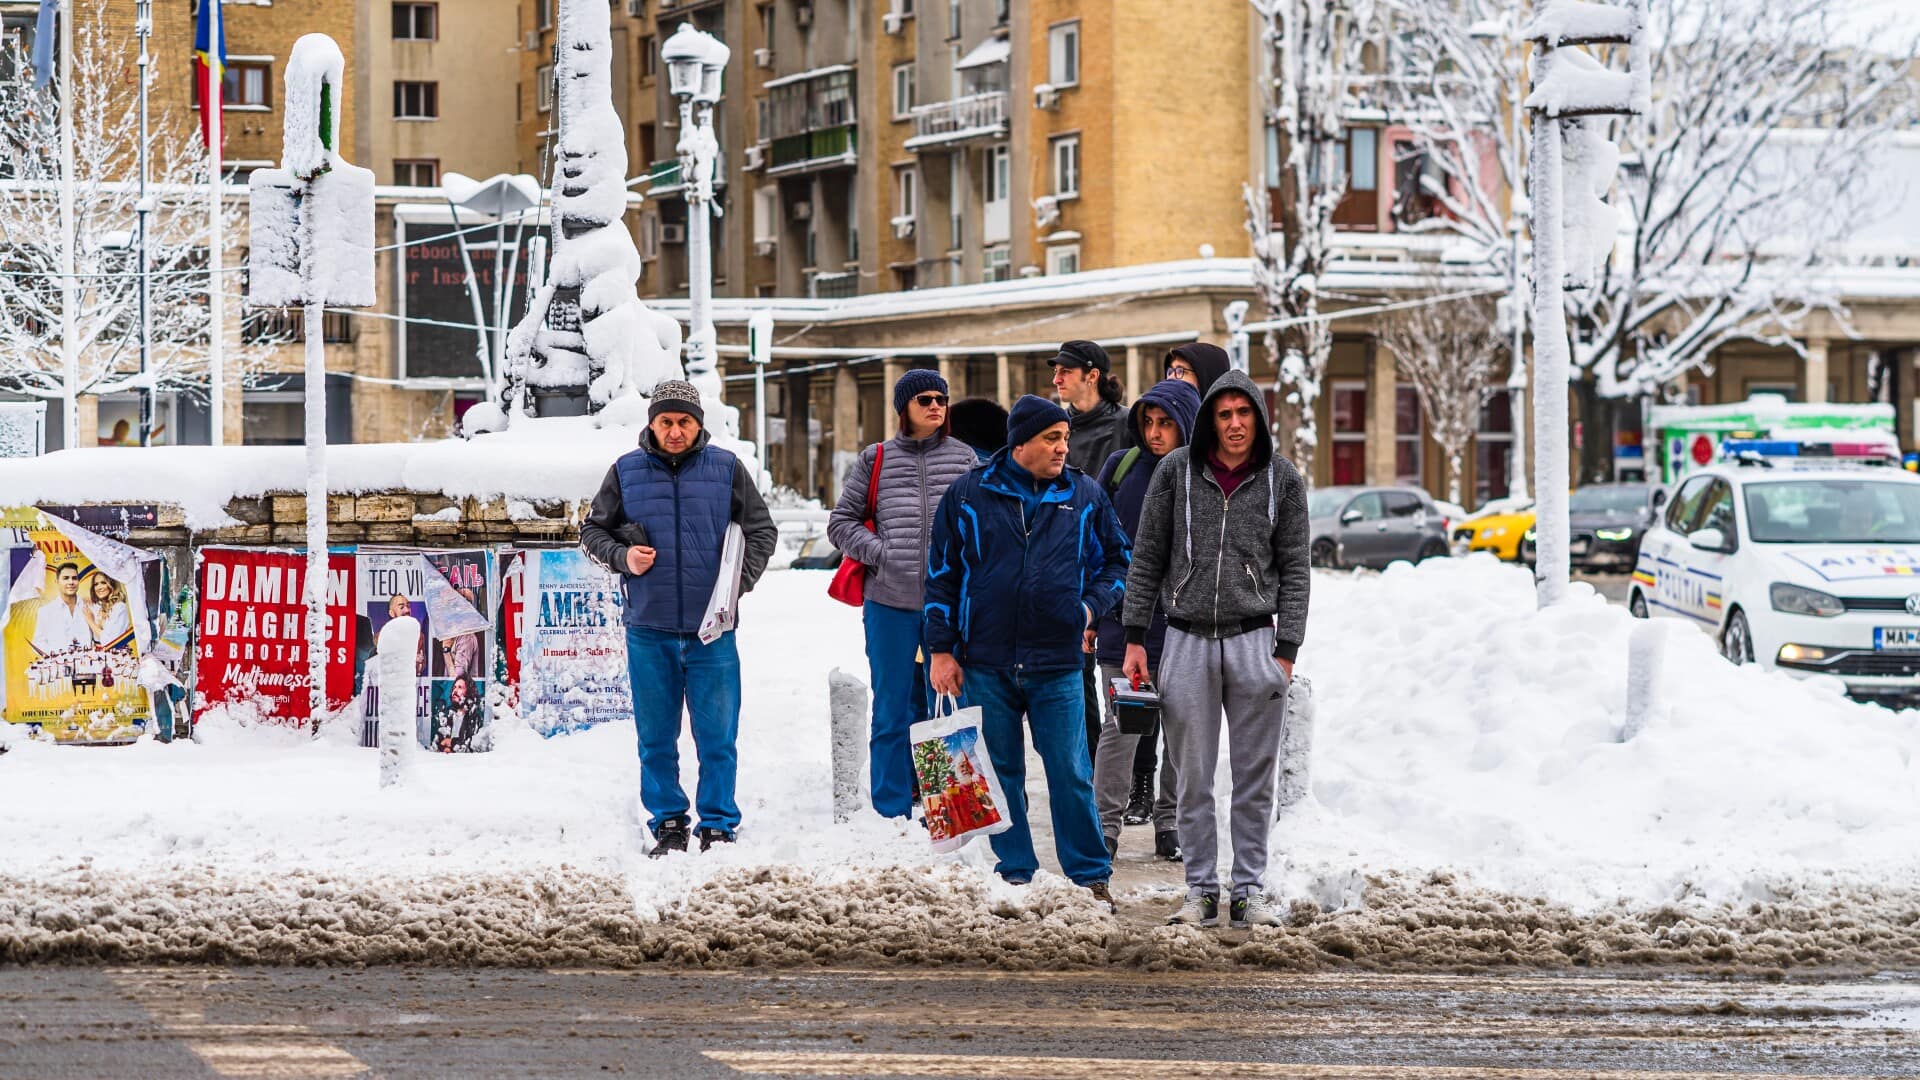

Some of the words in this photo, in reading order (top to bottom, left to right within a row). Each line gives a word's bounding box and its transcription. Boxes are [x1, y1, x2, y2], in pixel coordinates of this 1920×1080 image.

[432, 266, 491, 285] Inst
[206, 562, 349, 607] DAMIN
[406, 569, 424, 596] VI
[229, 643, 347, 664] BROTHRS
